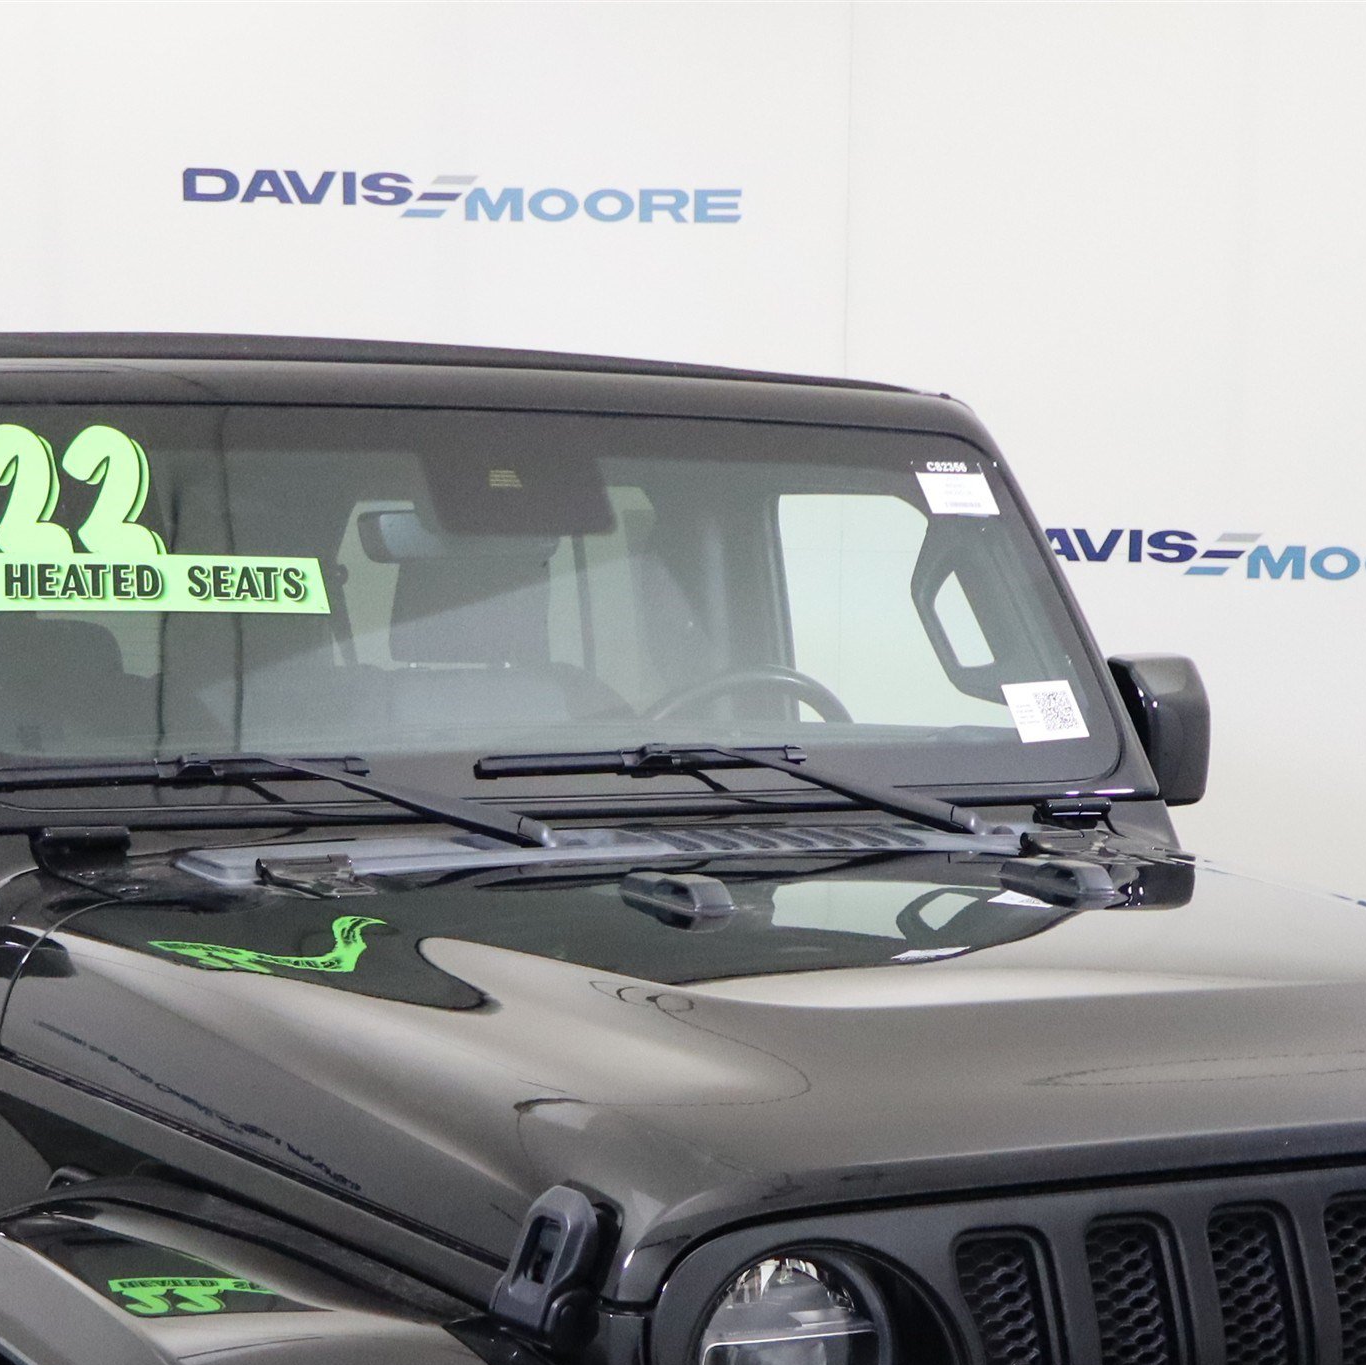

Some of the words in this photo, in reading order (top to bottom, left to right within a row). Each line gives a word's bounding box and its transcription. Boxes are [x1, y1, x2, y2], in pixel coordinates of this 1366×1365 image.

[182, 167, 414, 206] DAVIS
[464, 187, 743, 224] MOORE
[4, 563, 164, 600] HEATED
[187, 565, 306, 600] SEATS
